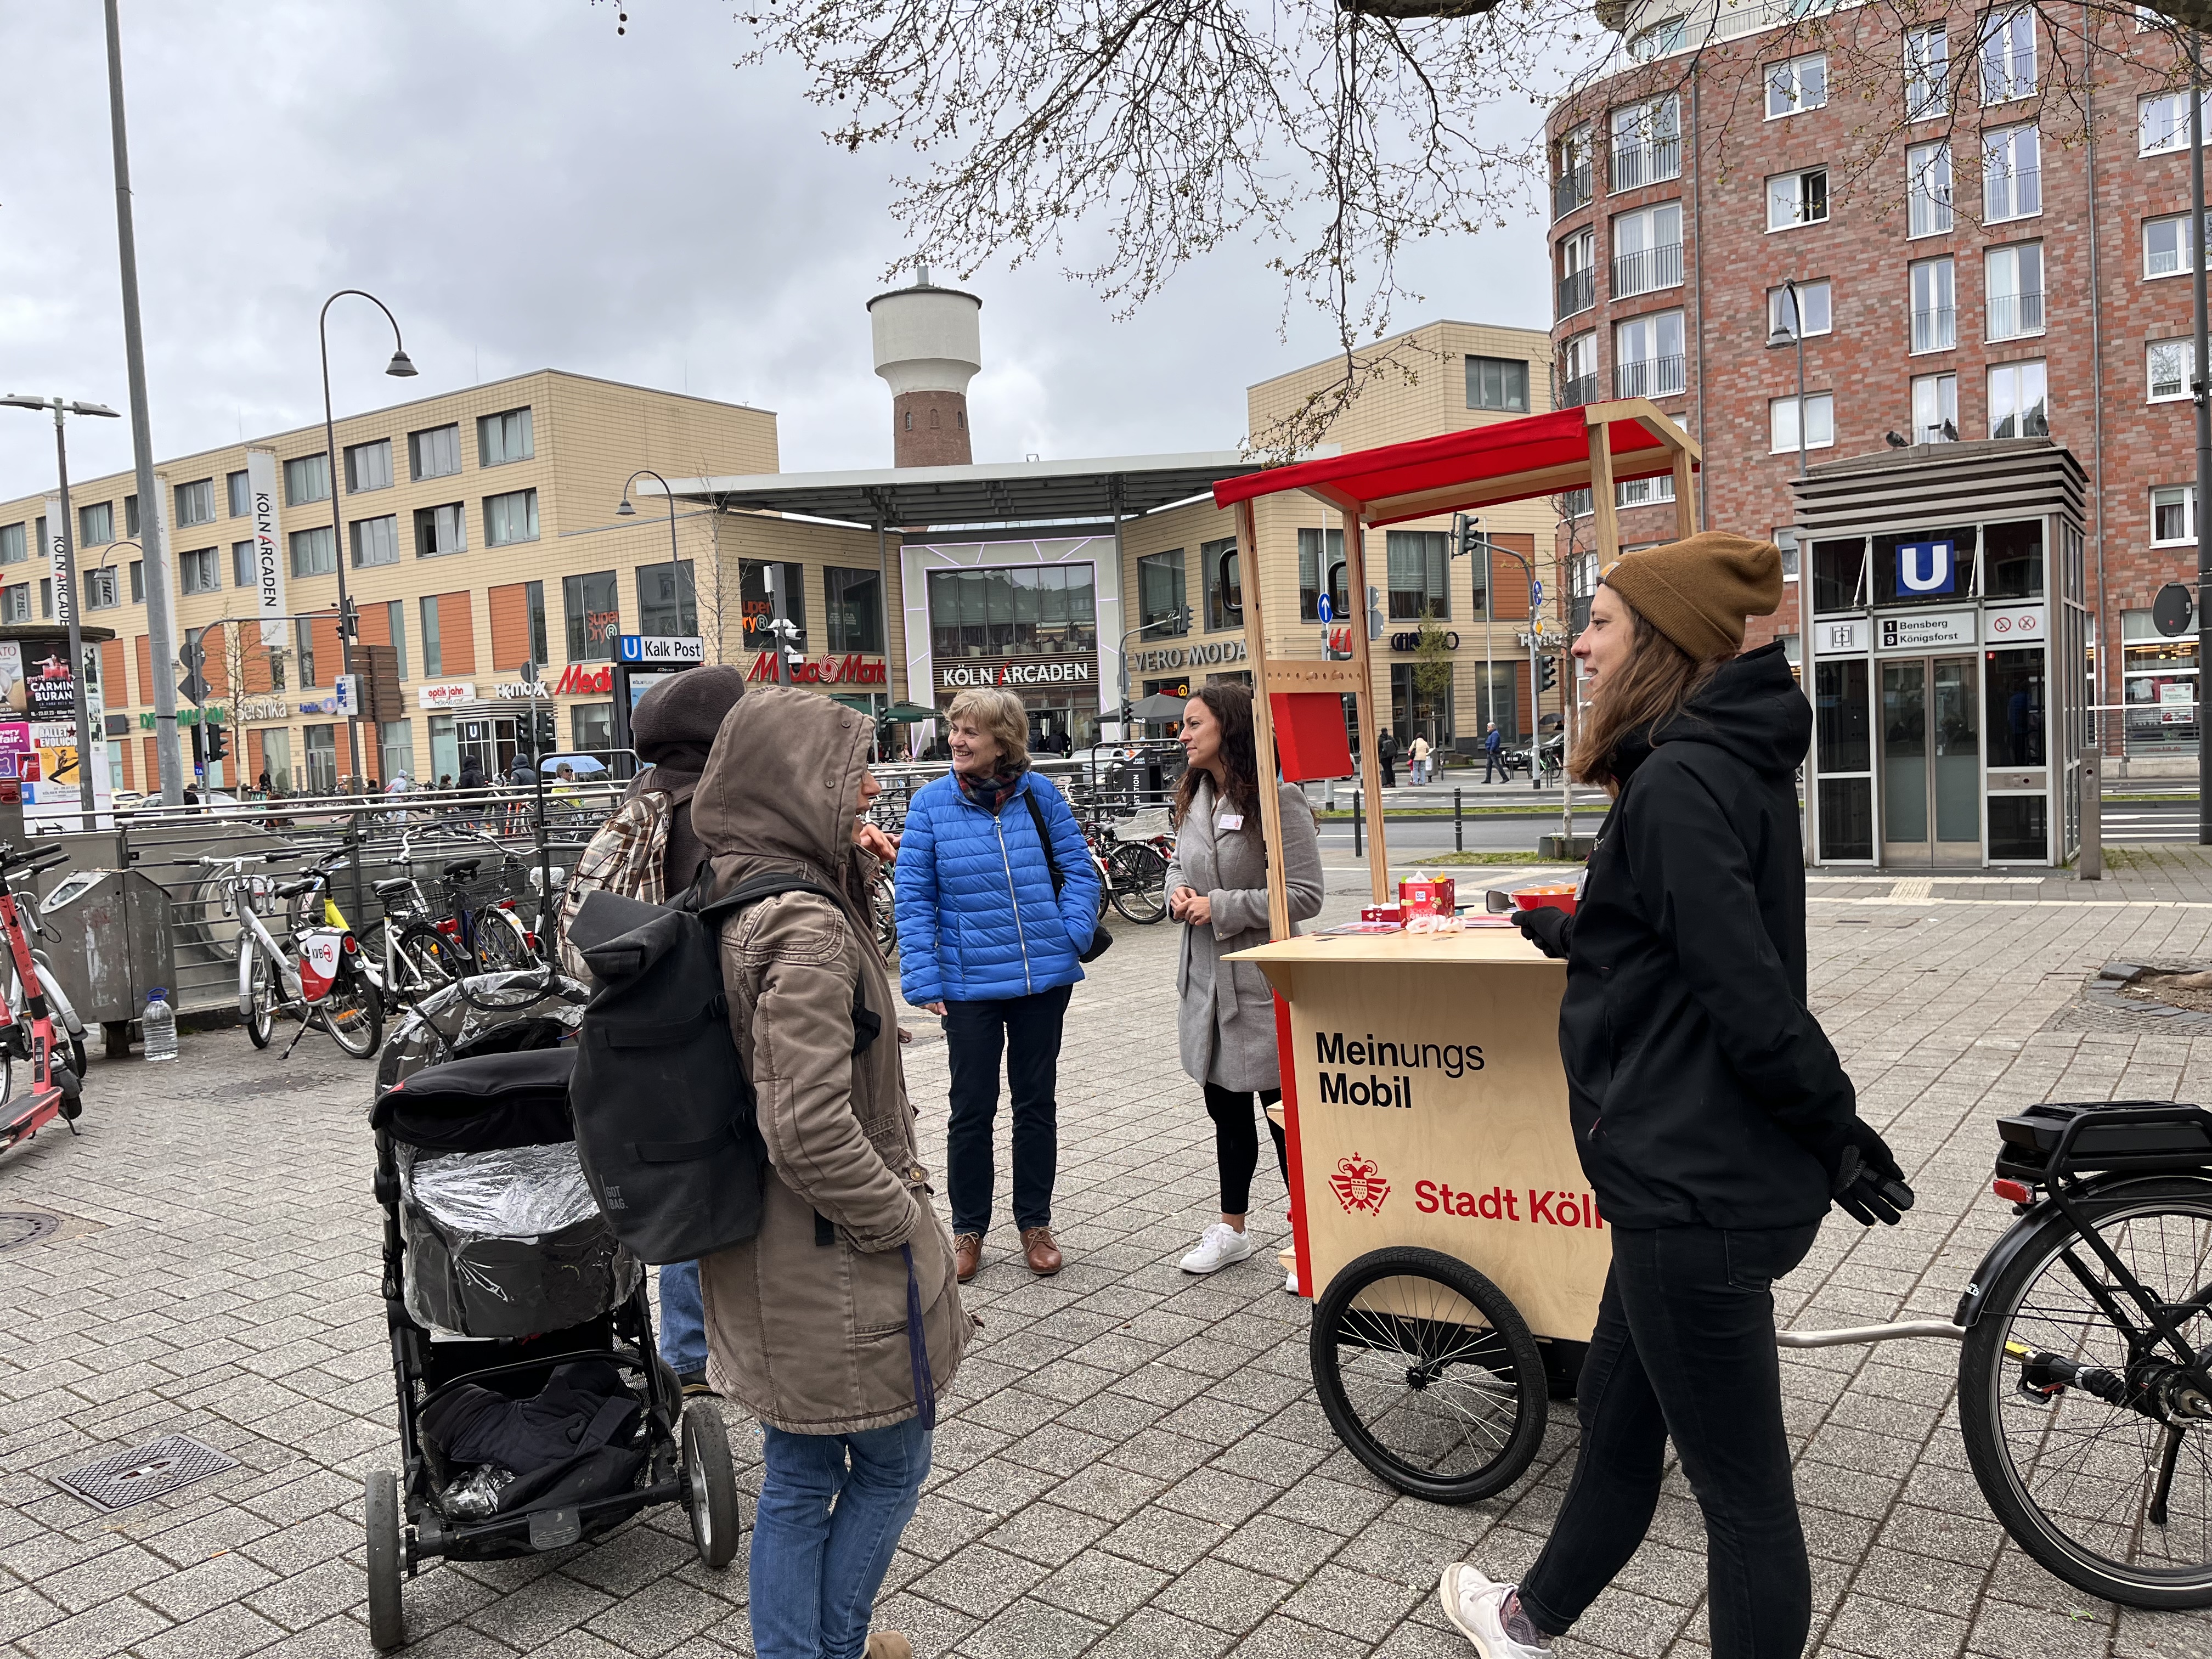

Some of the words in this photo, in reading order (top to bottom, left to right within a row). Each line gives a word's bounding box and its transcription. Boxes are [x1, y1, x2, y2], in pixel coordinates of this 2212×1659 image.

[256, 493, 273, 532] KÖLN
[258, 535, 278, 606] ARCADEN
[1901, 544, 1948, 590] U
[742, 601, 770, 618] uper
[1887, 623, 1892, 631] 1
[1900, 620, 1948, 630] Bensberg
[1887, 636, 1894, 644] 9
[1900, 632, 1958, 644] Königsforst
[623, 638, 638, 658] U
[645, 641, 670, 657] Kalk
[674, 641, 701, 657] Post
[1134, 648, 1181, 671] VERO
[1187, 638, 1248, 665] MODA
[745, 651, 819, 682] Mdia
[943, 664, 994, 686] KÖLN
[997, 659, 1088, 686] ARCADEN
[35, 691, 74, 702] BURAN
[428, 687, 446, 701] optik
[448, 686, 464, 700] jahn
[39, 728, 67, 738] BALLET
[469, 725, 477, 737] U
[312, 948, 324, 959] KVB
[1316, 1032, 1485, 1079] Meinungs
[1319, 1072, 1412, 1108] Mobil
[606, 1186, 620, 1198] GOT
[1414, 1180, 1520, 1222] Stadt
[608, 1198, 629, 1210] BAG.
